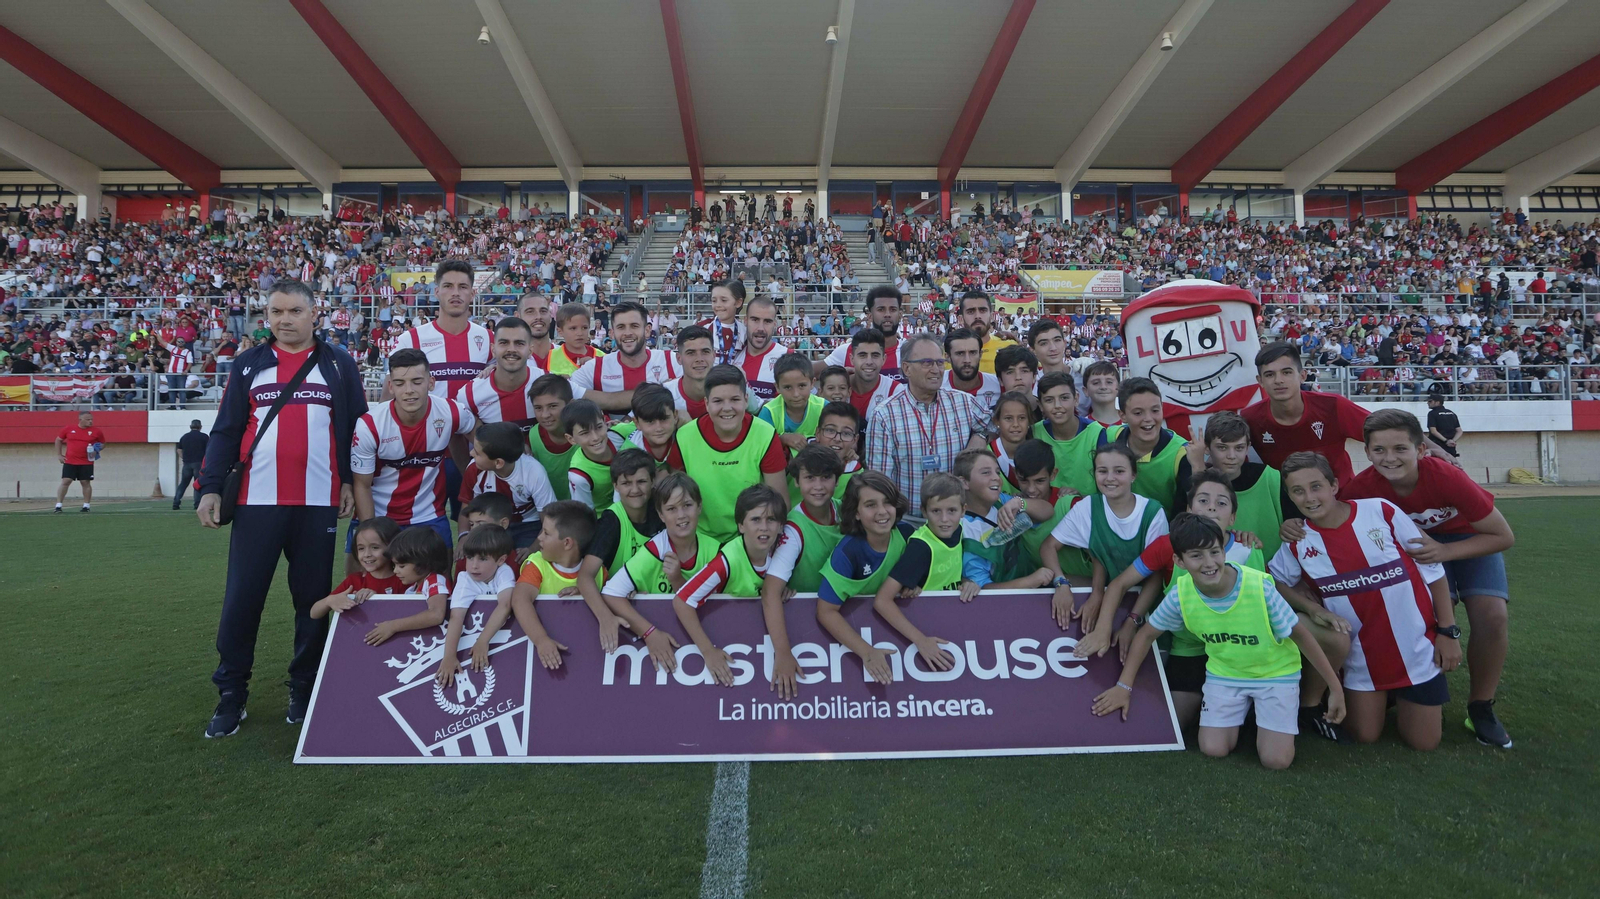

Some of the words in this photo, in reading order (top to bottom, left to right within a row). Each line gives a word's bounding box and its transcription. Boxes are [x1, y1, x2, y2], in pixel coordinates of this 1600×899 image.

[602, 627, 1088, 686] masterhouse
[434, 708, 495, 741] ALGECIRAS
[496, 698, 516, 713] C.F.
[719, 698, 744, 720] La
[752, 696, 891, 720] inmobiliaria
[897, 694, 994, 718] sincera.
